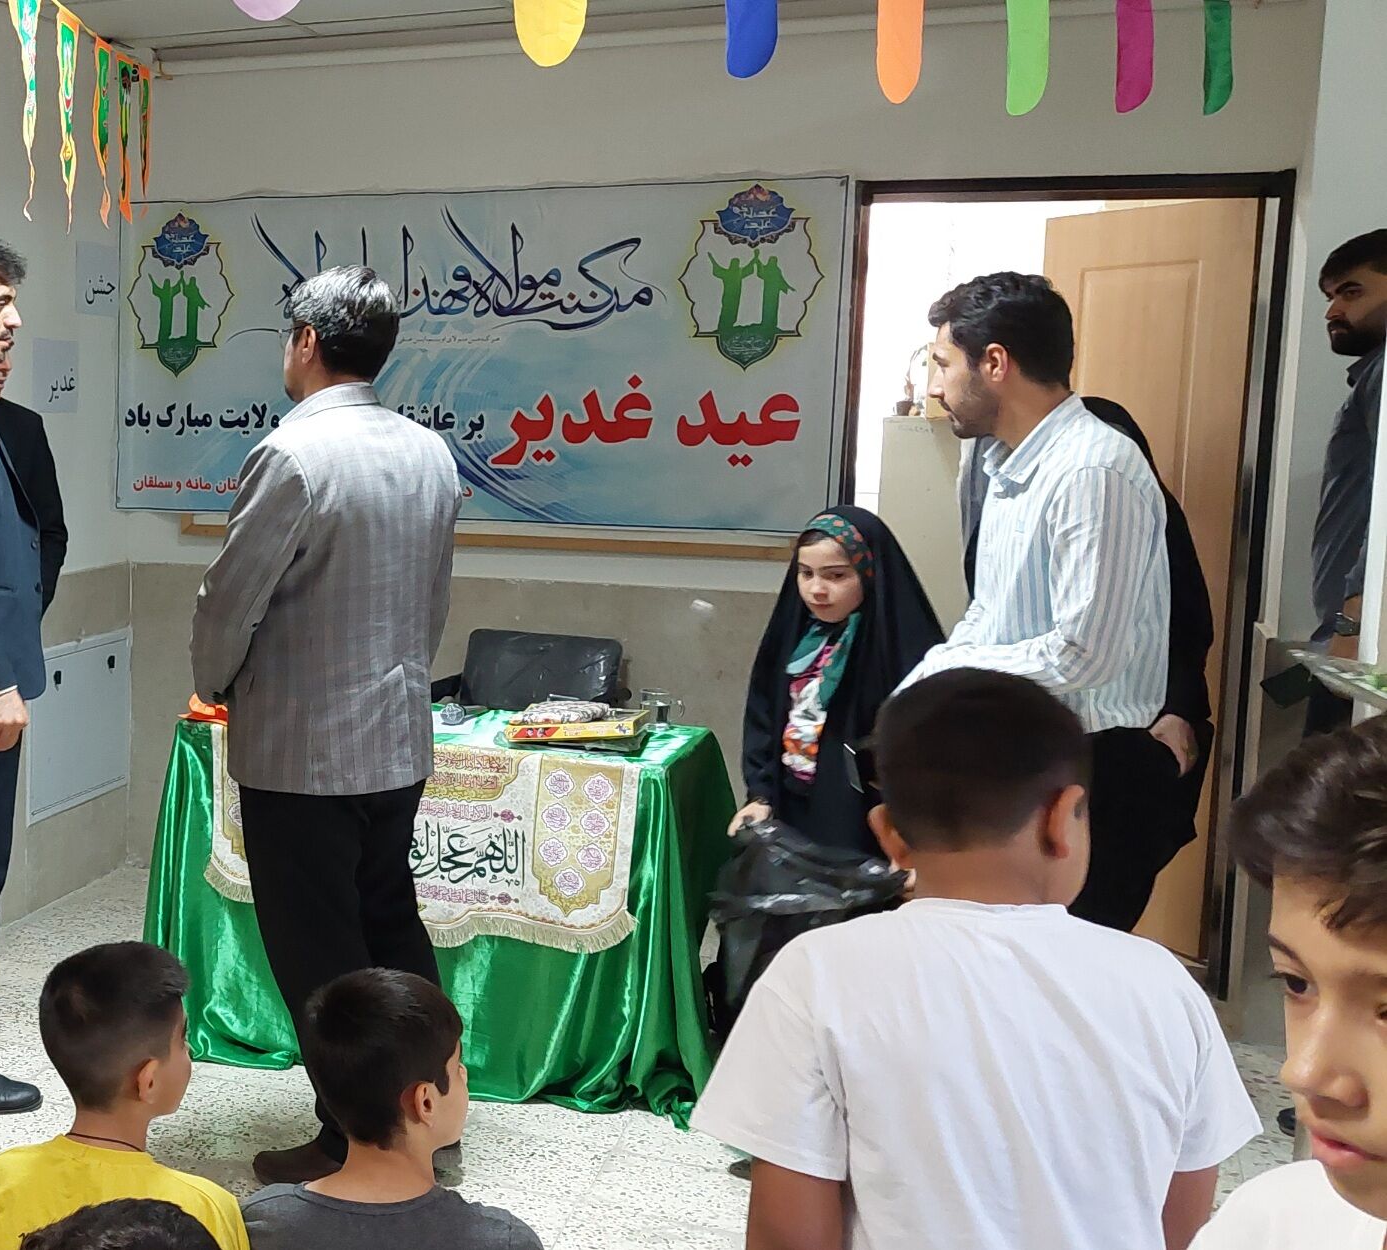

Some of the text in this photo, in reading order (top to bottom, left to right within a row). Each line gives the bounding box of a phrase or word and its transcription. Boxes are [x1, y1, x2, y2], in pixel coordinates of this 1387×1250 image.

[85, 274, 116, 305] جشن
[48, 367, 76, 403] غدیر
[124, 402, 151, 434] باد
[156, 402, 213, 436] مبارک
[461, 413, 485, 440] بر
[491, 374, 801, 467] عید غدیر
[133, 475, 173, 491] سملقان
[175, 479, 182, 493] و
[186, 477, 212, 490] مانه
